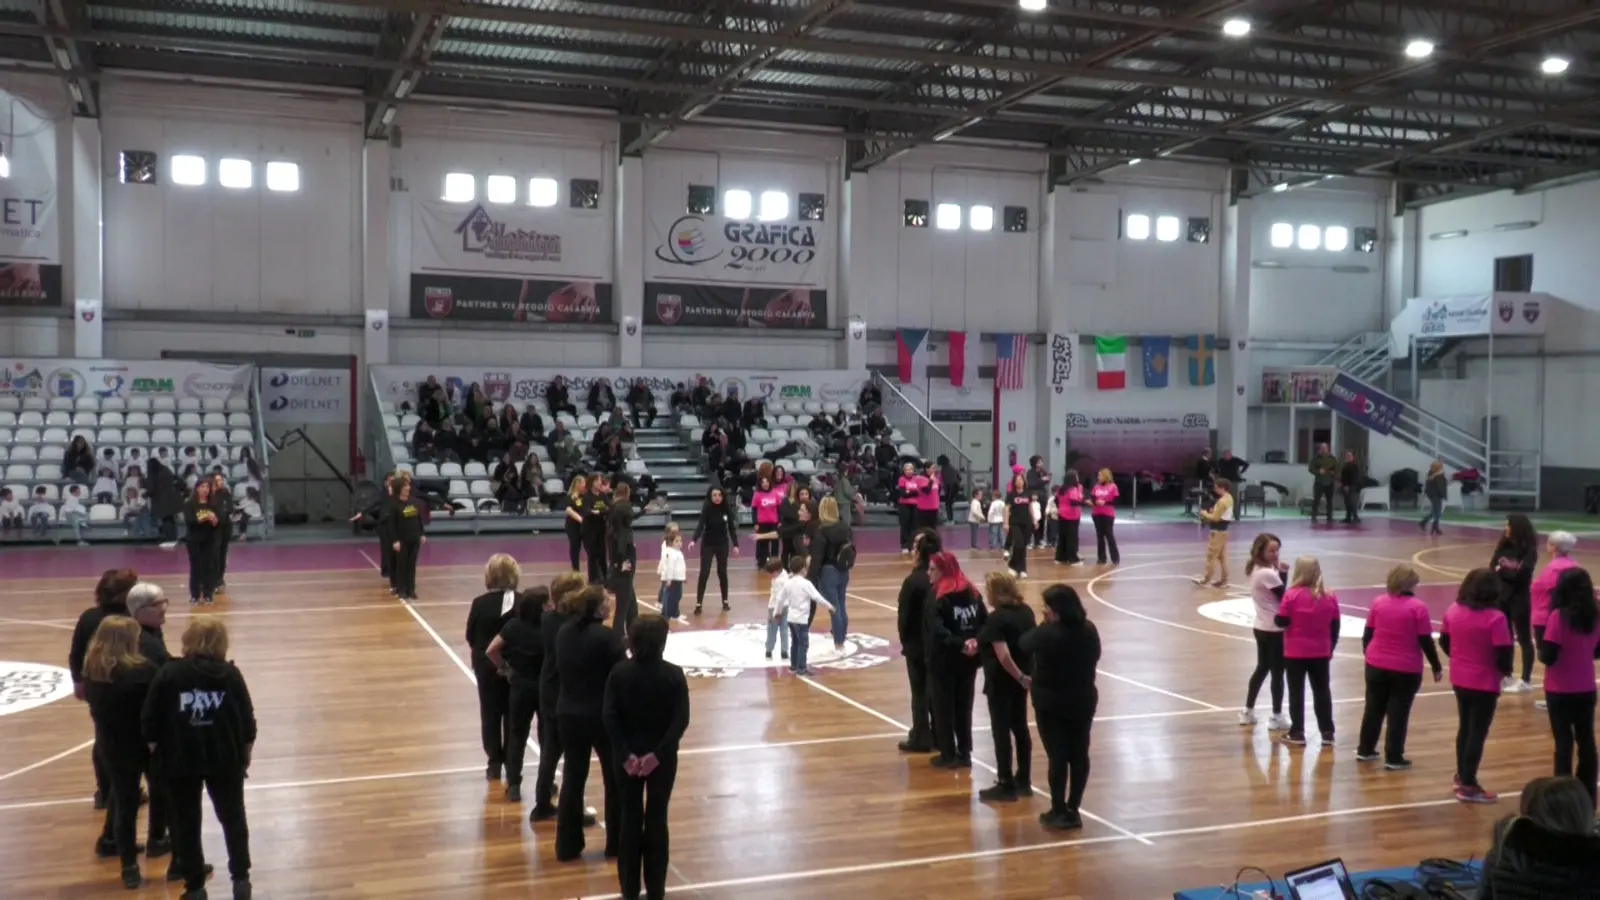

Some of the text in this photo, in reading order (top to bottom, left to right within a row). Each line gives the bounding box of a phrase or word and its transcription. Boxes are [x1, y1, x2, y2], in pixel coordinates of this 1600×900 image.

[724, 245, 815, 269] 2000
[456, 299, 600, 314] PARTNER VIS REGGIO CALABRIA
[685, 306, 816, 319] PARTNER VIS REGGIO CALABRIA
[290, 398, 340, 410] DIELNET
